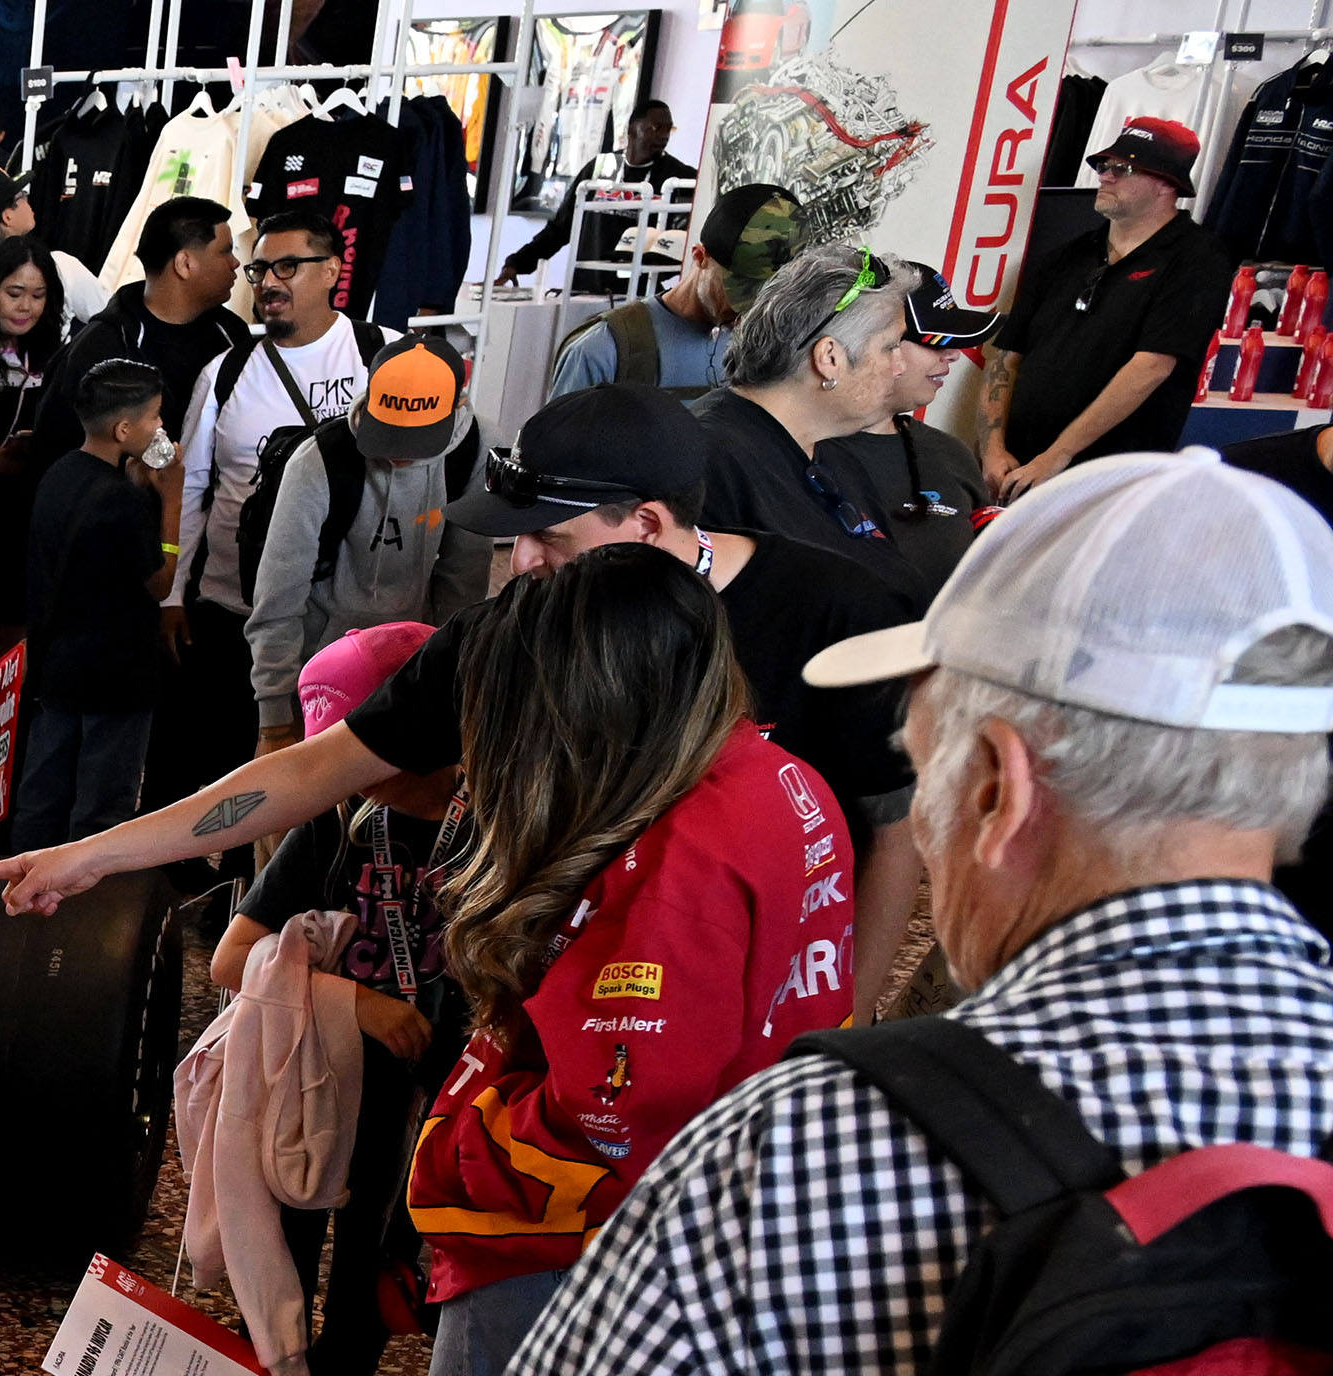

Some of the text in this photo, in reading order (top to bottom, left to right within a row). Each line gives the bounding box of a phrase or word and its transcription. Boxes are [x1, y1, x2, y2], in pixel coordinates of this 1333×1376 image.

[966, 55, 1049, 308] CURA
[386, 907, 413, 976] INDYCAR
[600, 963, 659, 982] BOSCH
[597, 982, 656, 996] Spark Plugs
[581, 1016, 665, 1033] First Alert
[89, 1316, 113, 1349] INDYCAR
[85, 1342, 101, 1358] 96
